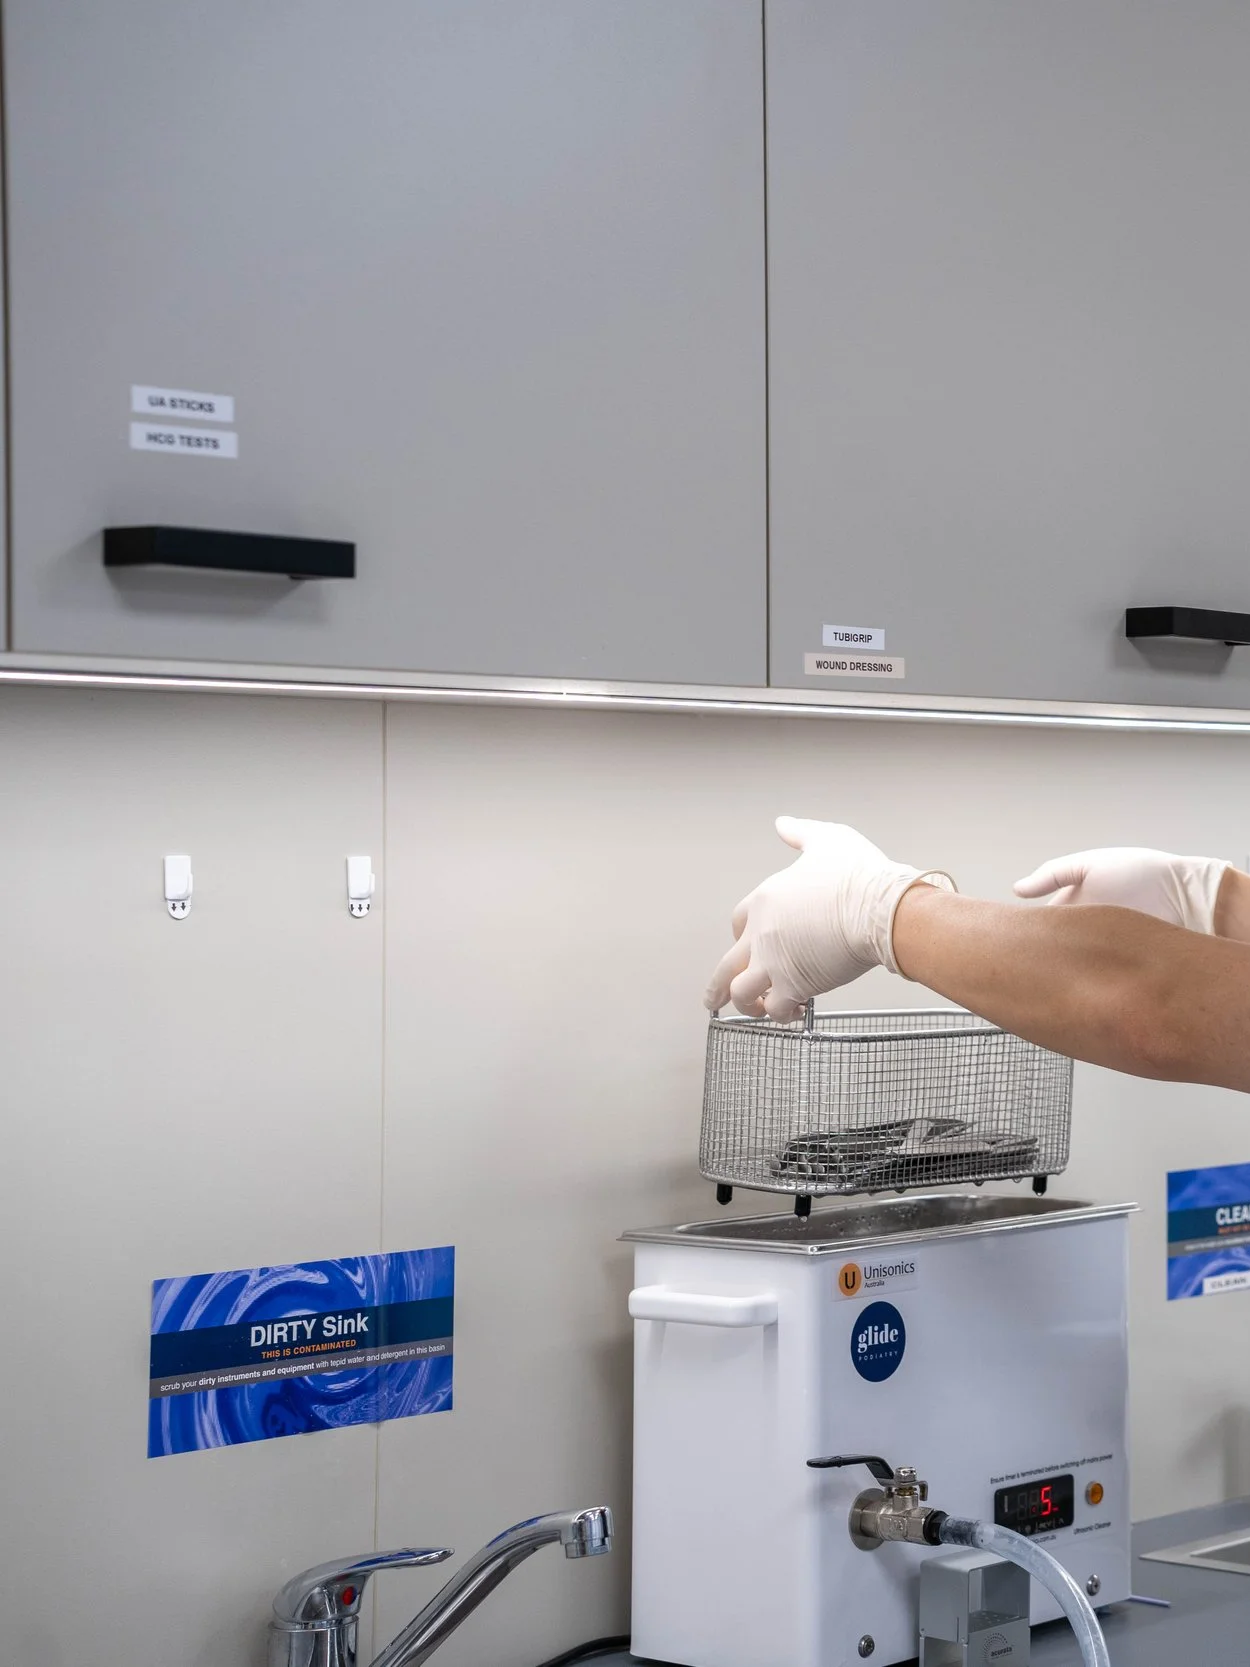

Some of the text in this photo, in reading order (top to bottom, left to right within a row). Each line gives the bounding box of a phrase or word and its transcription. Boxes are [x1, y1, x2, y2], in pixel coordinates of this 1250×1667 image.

[169, 397, 216, 414] STICKS
[179, 434, 220, 450] TESTS
[833, 632, 873, 644] TUBIGRIP
[815, 660, 893, 673] WOUND DRESSING
[864, 1261, 916, 1280] Unisonics
[844, 1271, 856, 1290] U
[864, 1280, 886, 1289] Australia
[250, 1312, 369, 1348] DIRTY Sink
[857, 1323, 899, 1354] glide
[261, 1339, 357, 1360] THIS IS CONTAMINATED
[160, 1343, 446, 1392] scrub your dirty instruments and equipment with tepid water and detergent in this basin
